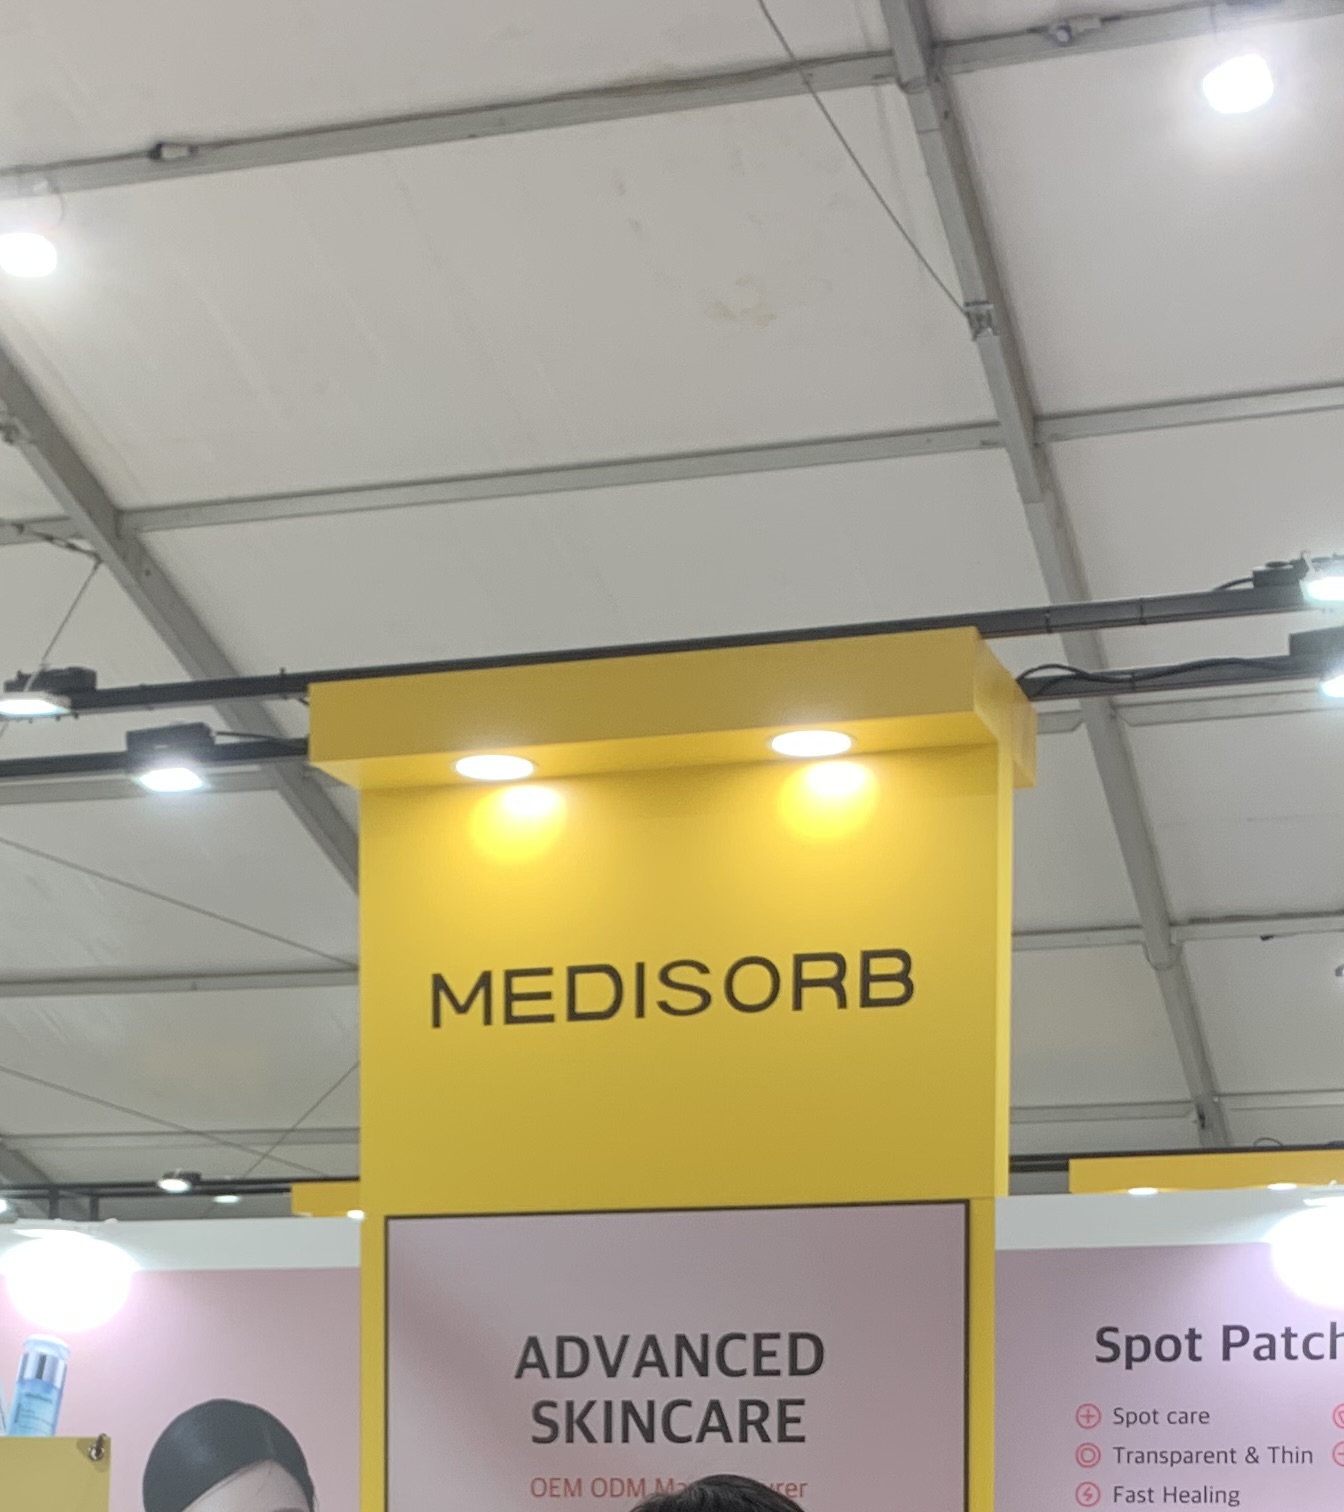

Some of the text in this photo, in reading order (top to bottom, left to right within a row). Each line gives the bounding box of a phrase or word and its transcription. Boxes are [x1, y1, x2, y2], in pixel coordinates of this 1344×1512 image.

[430, 947, 915, 1029] MEDISORB
[514, 1331, 825, 1379] ADVANCED
[1094, 1325, 1203, 1371] Spot
[530, 1398, 807, 1444] SKINCARE
[1112, 1407, 1211, 1428] Spot care
[1112, 1445, 1314, 1468] Transparent & Thin
[529, 1477, 583, 1498] OEM
[590, 1477, 646, 1498] ODM
[1112, 1485, 1241, 1507] Fast Healing
